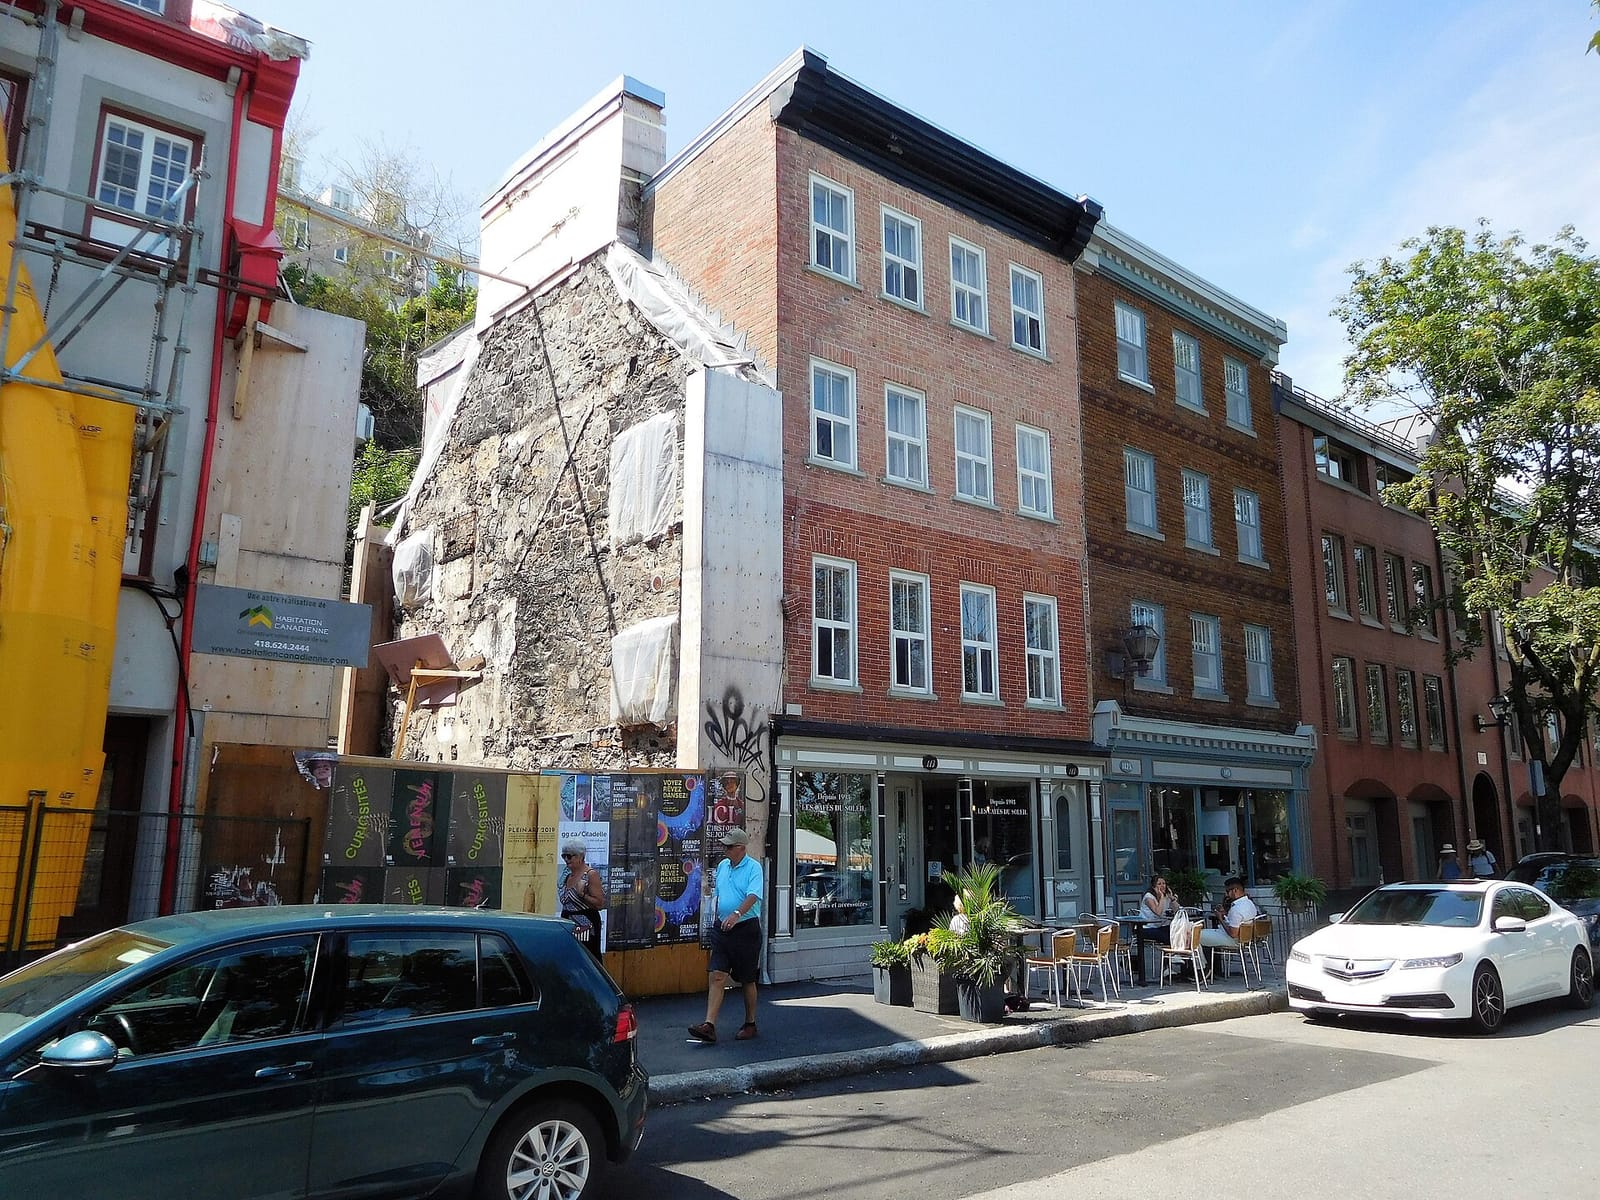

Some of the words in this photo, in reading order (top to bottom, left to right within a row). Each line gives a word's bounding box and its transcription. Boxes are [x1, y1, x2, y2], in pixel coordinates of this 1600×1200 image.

[275, 615, 323, 626] HABITATION
[274, 622, 329, 634] CANADIENNE
[254, 640, 310, 652] 418.624.2444
[210, 646, 349, 665] www.habitationcanadienne.com
[818, 792, 836, 802] Depuis
[990, 798, 1006, 806] Depuis
[706, 806, 735, 824] ICI
